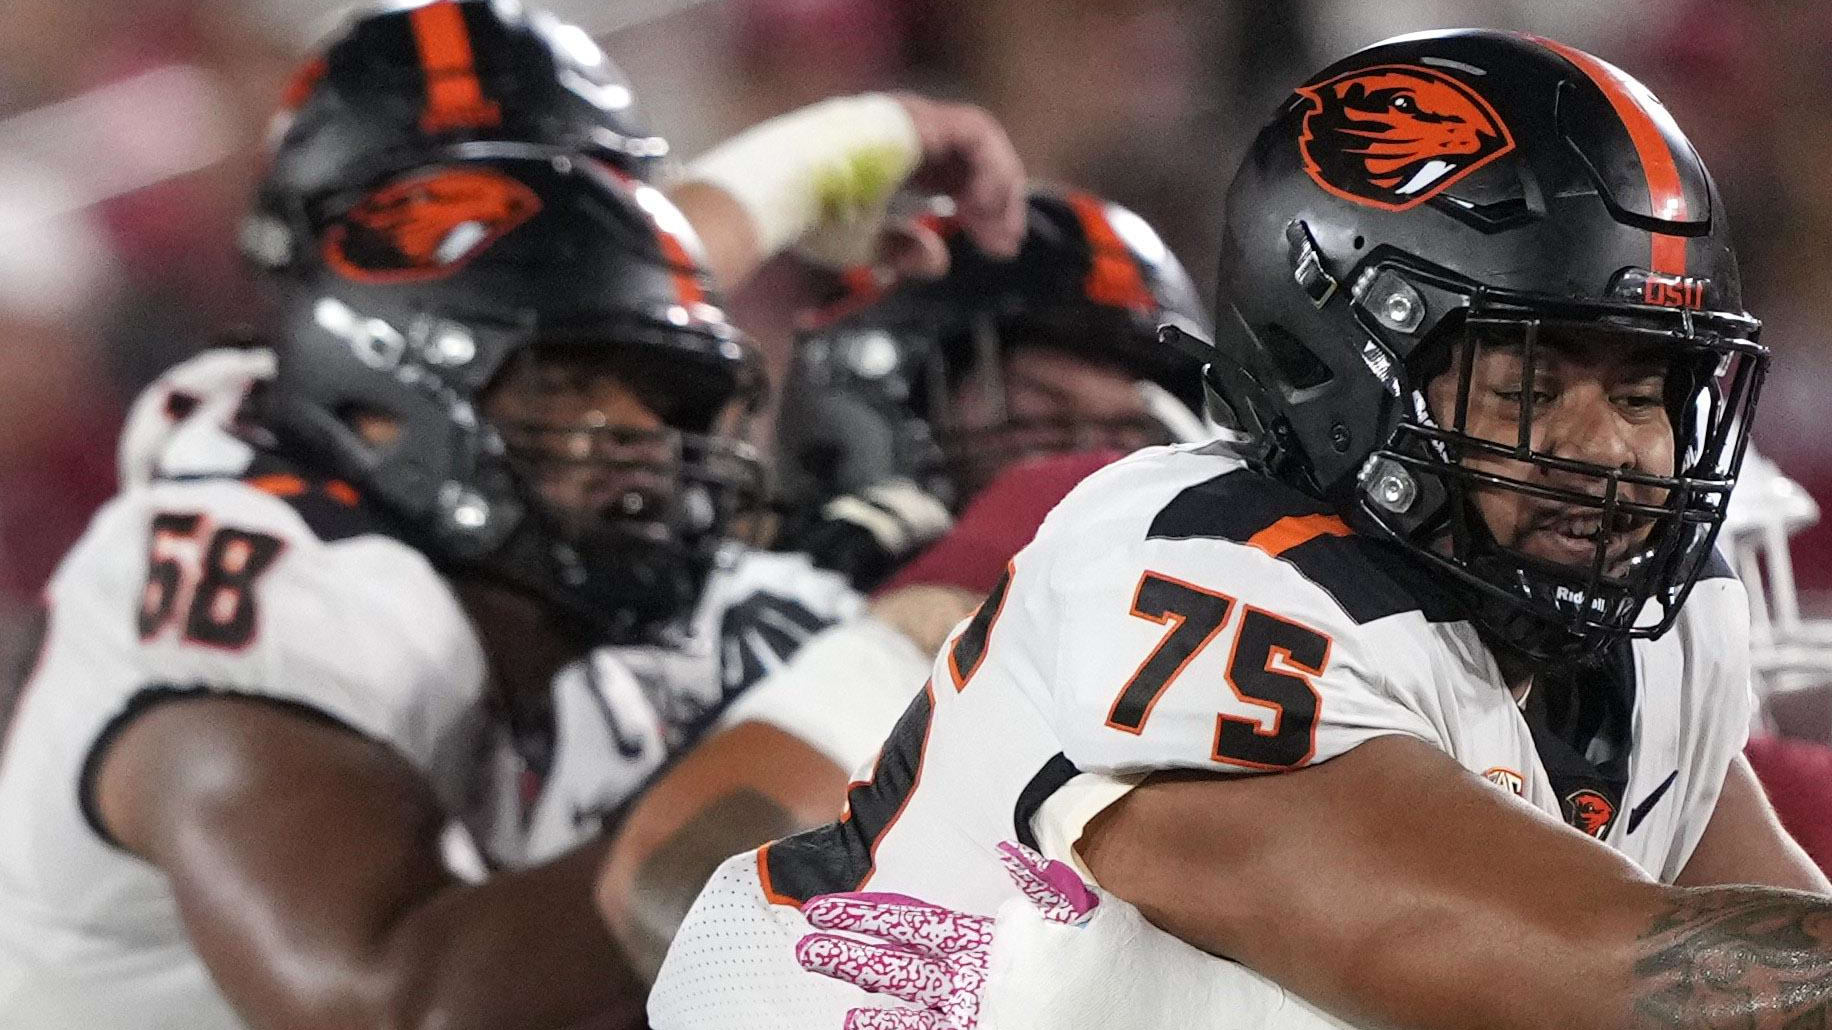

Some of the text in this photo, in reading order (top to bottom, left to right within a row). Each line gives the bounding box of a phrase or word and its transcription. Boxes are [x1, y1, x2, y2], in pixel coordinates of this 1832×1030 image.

[1644, 276, 1704, 311] OSU
[139, 511, 286, 650] 58
[1105, 569, 1334, 774] 75
